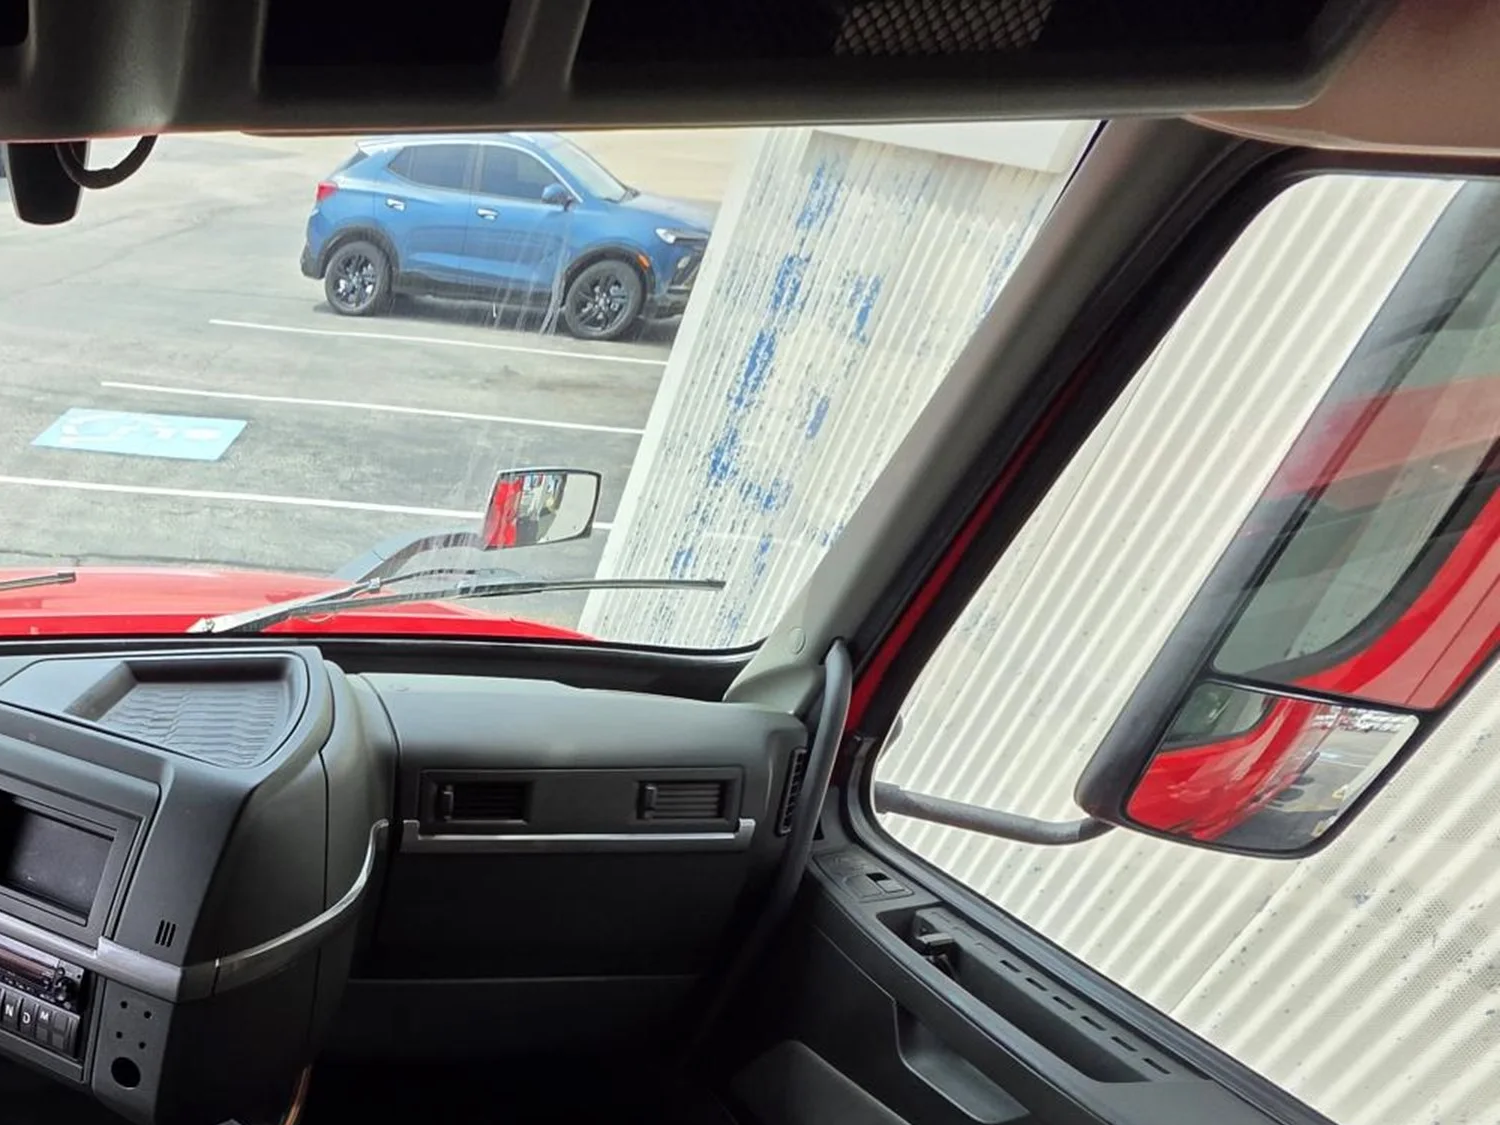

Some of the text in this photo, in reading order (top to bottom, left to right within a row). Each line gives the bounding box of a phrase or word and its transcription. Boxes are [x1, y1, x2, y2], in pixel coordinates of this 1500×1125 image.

[5, 1004, 14, 1017] N
[22, 1012, 31, 1024] D
[40, 1011, 49, 1021] M
